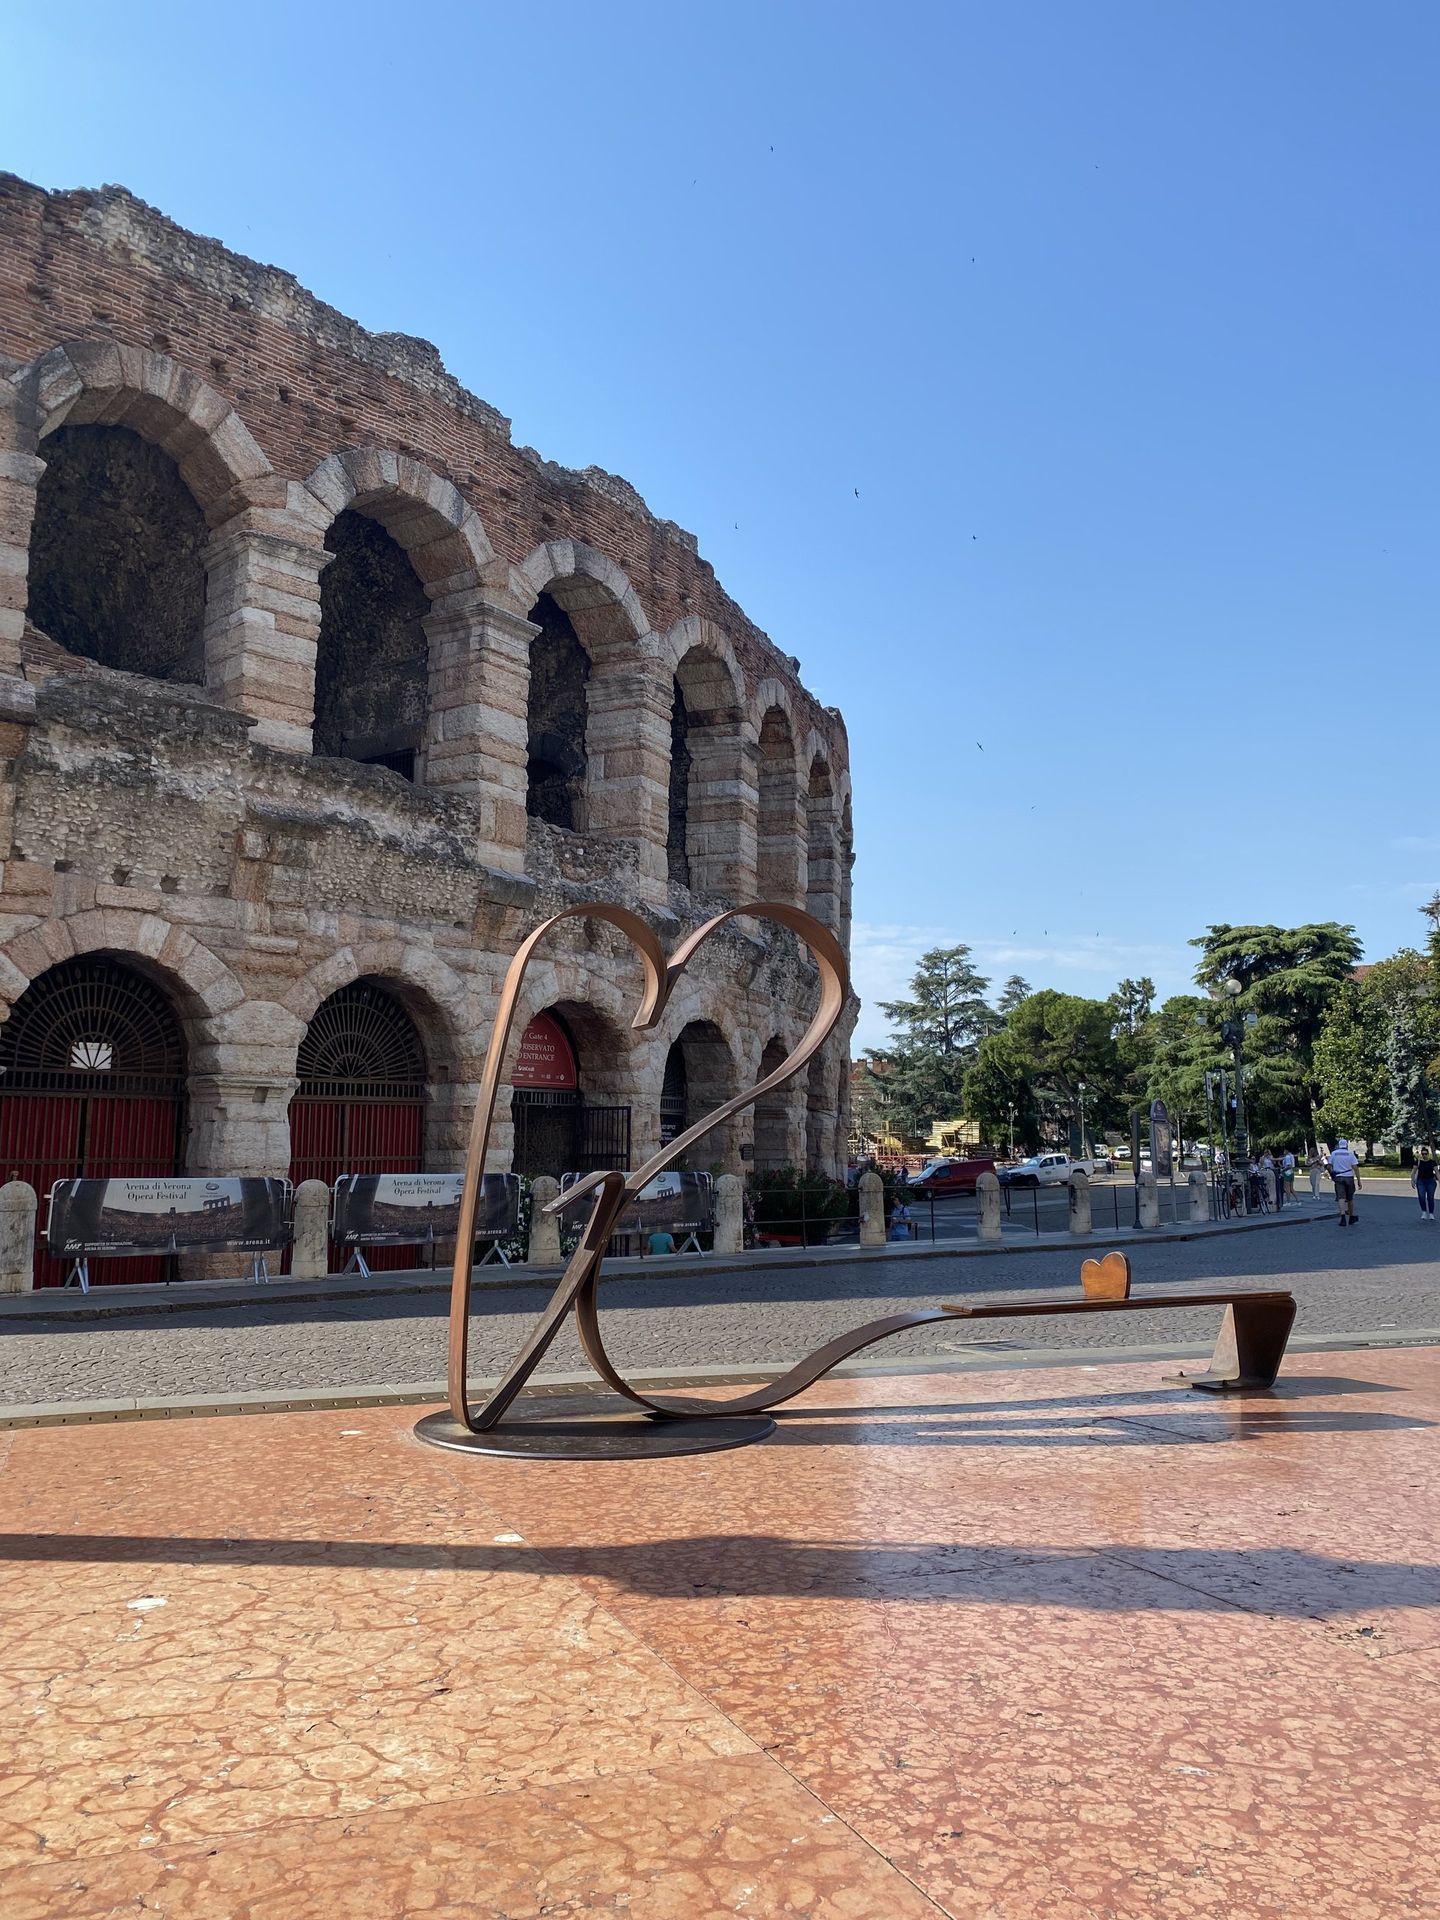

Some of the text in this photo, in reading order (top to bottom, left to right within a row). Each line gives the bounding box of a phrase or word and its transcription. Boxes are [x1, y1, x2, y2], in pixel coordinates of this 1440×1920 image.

[528, 1032, 543, 1040] Gate
[522, 1043, 555, 1052] RISERVATO
[523, 1052, 555, 1061] ENTRANCE
[124, 1182, 191, 1190] Arena di Verona
[413, 1178, 421, 1186] di
[422, 1178, 445, 1186] Verona
[394, 1187, 414, 1196] Opera
[127, 1191, 187, 1202] Opera Festival
[226, 1238, 271, 1246] www.arena.it
